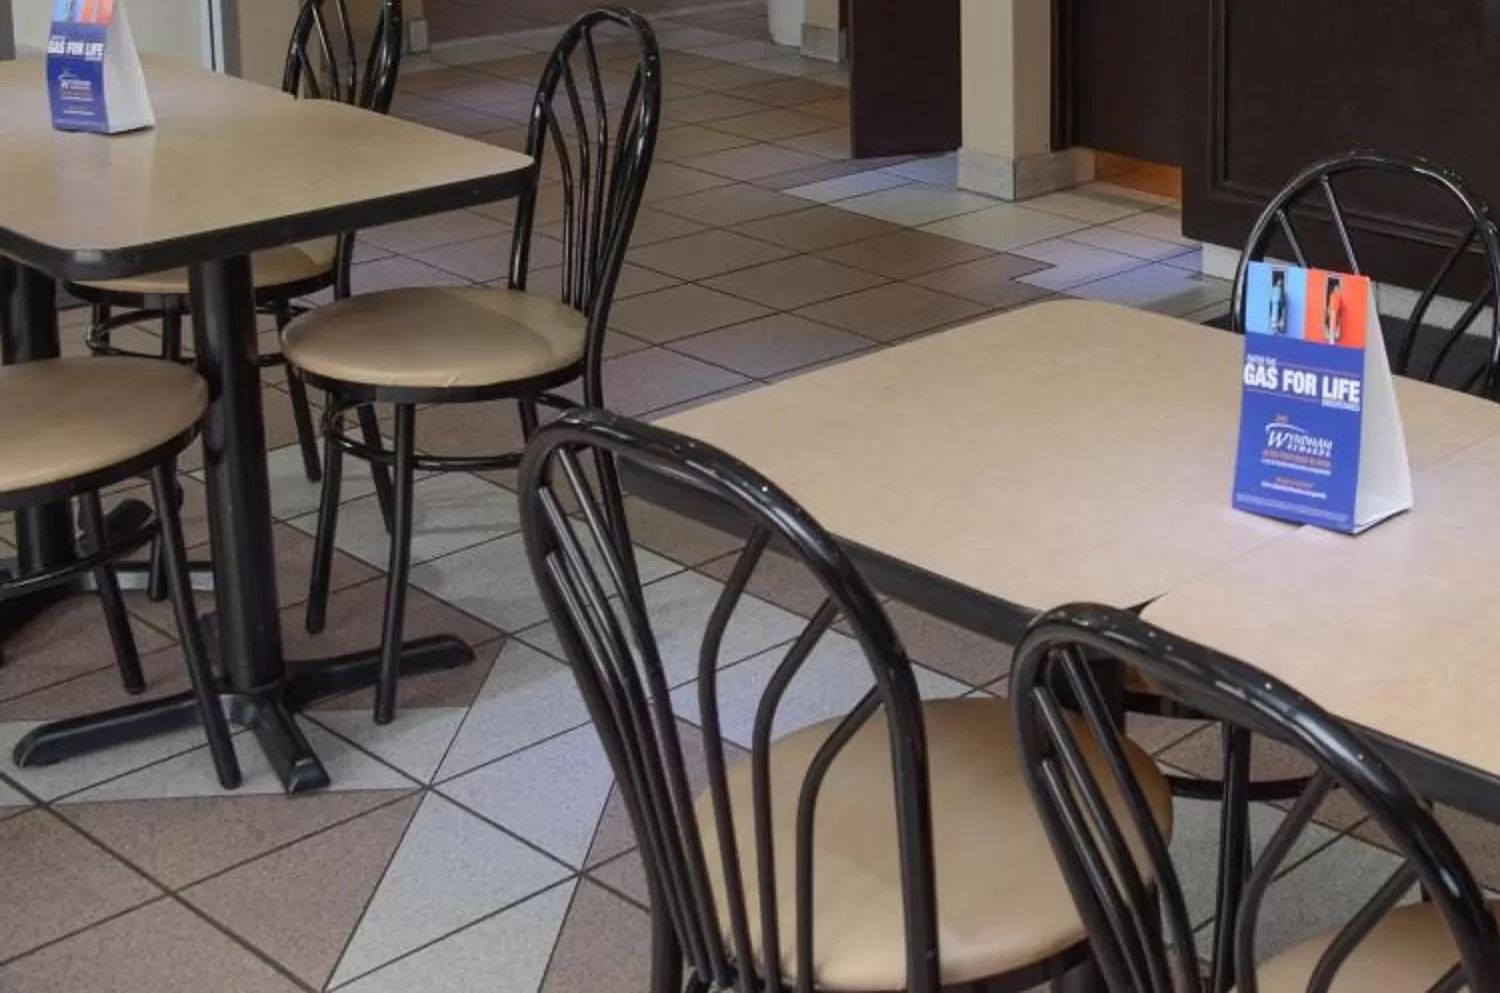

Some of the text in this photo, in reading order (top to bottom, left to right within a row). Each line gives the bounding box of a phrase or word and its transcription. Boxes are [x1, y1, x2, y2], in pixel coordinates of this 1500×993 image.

[1243, 363, 1361, 404] GAS FOR LIFE
